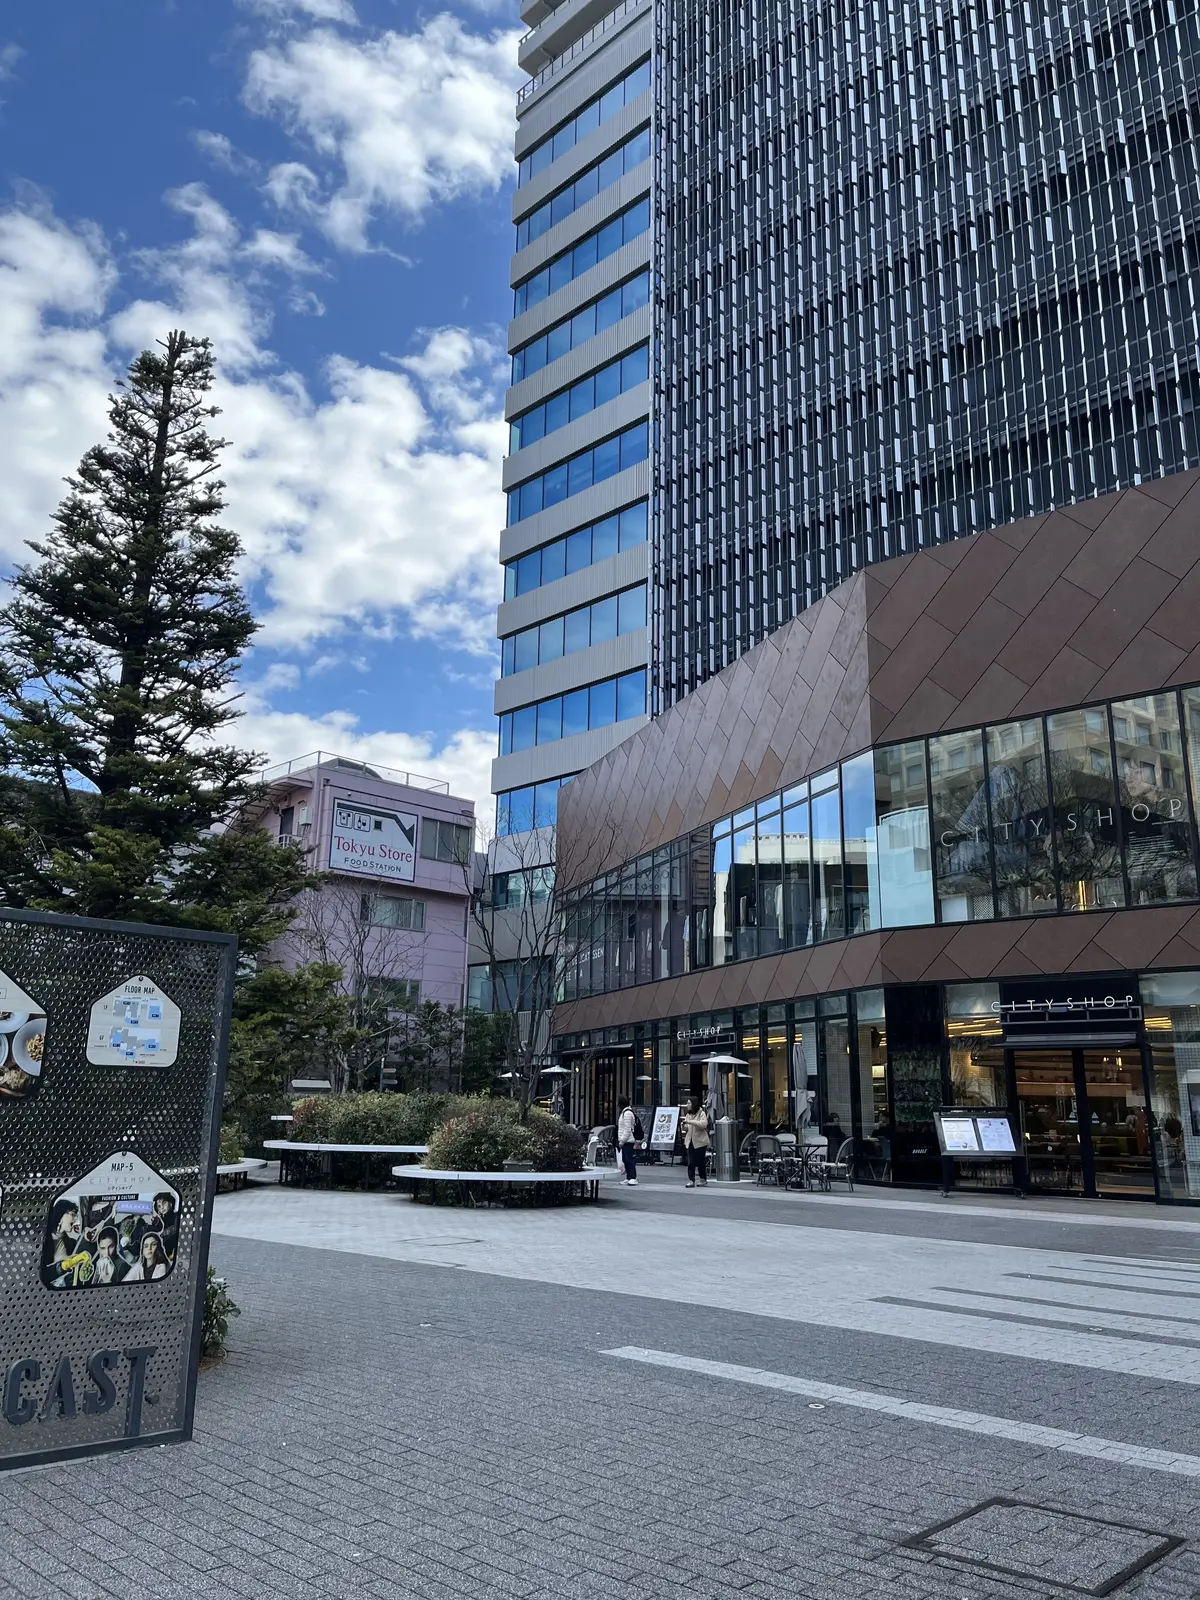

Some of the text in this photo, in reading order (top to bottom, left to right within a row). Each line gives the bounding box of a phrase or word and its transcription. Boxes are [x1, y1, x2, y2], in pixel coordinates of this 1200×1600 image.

[941, 798, 1182, 847] CITYSHOP
[334, 836, 412, 863] Tokyu Store
[124, 985, 155, 994] FLOOR MAP
[990, 995, 1134, 1012] CITYSHOP
[111, 1162, 134, 1171] MAP-5
[89, 1176, 151, 1184] CITYSHOP
